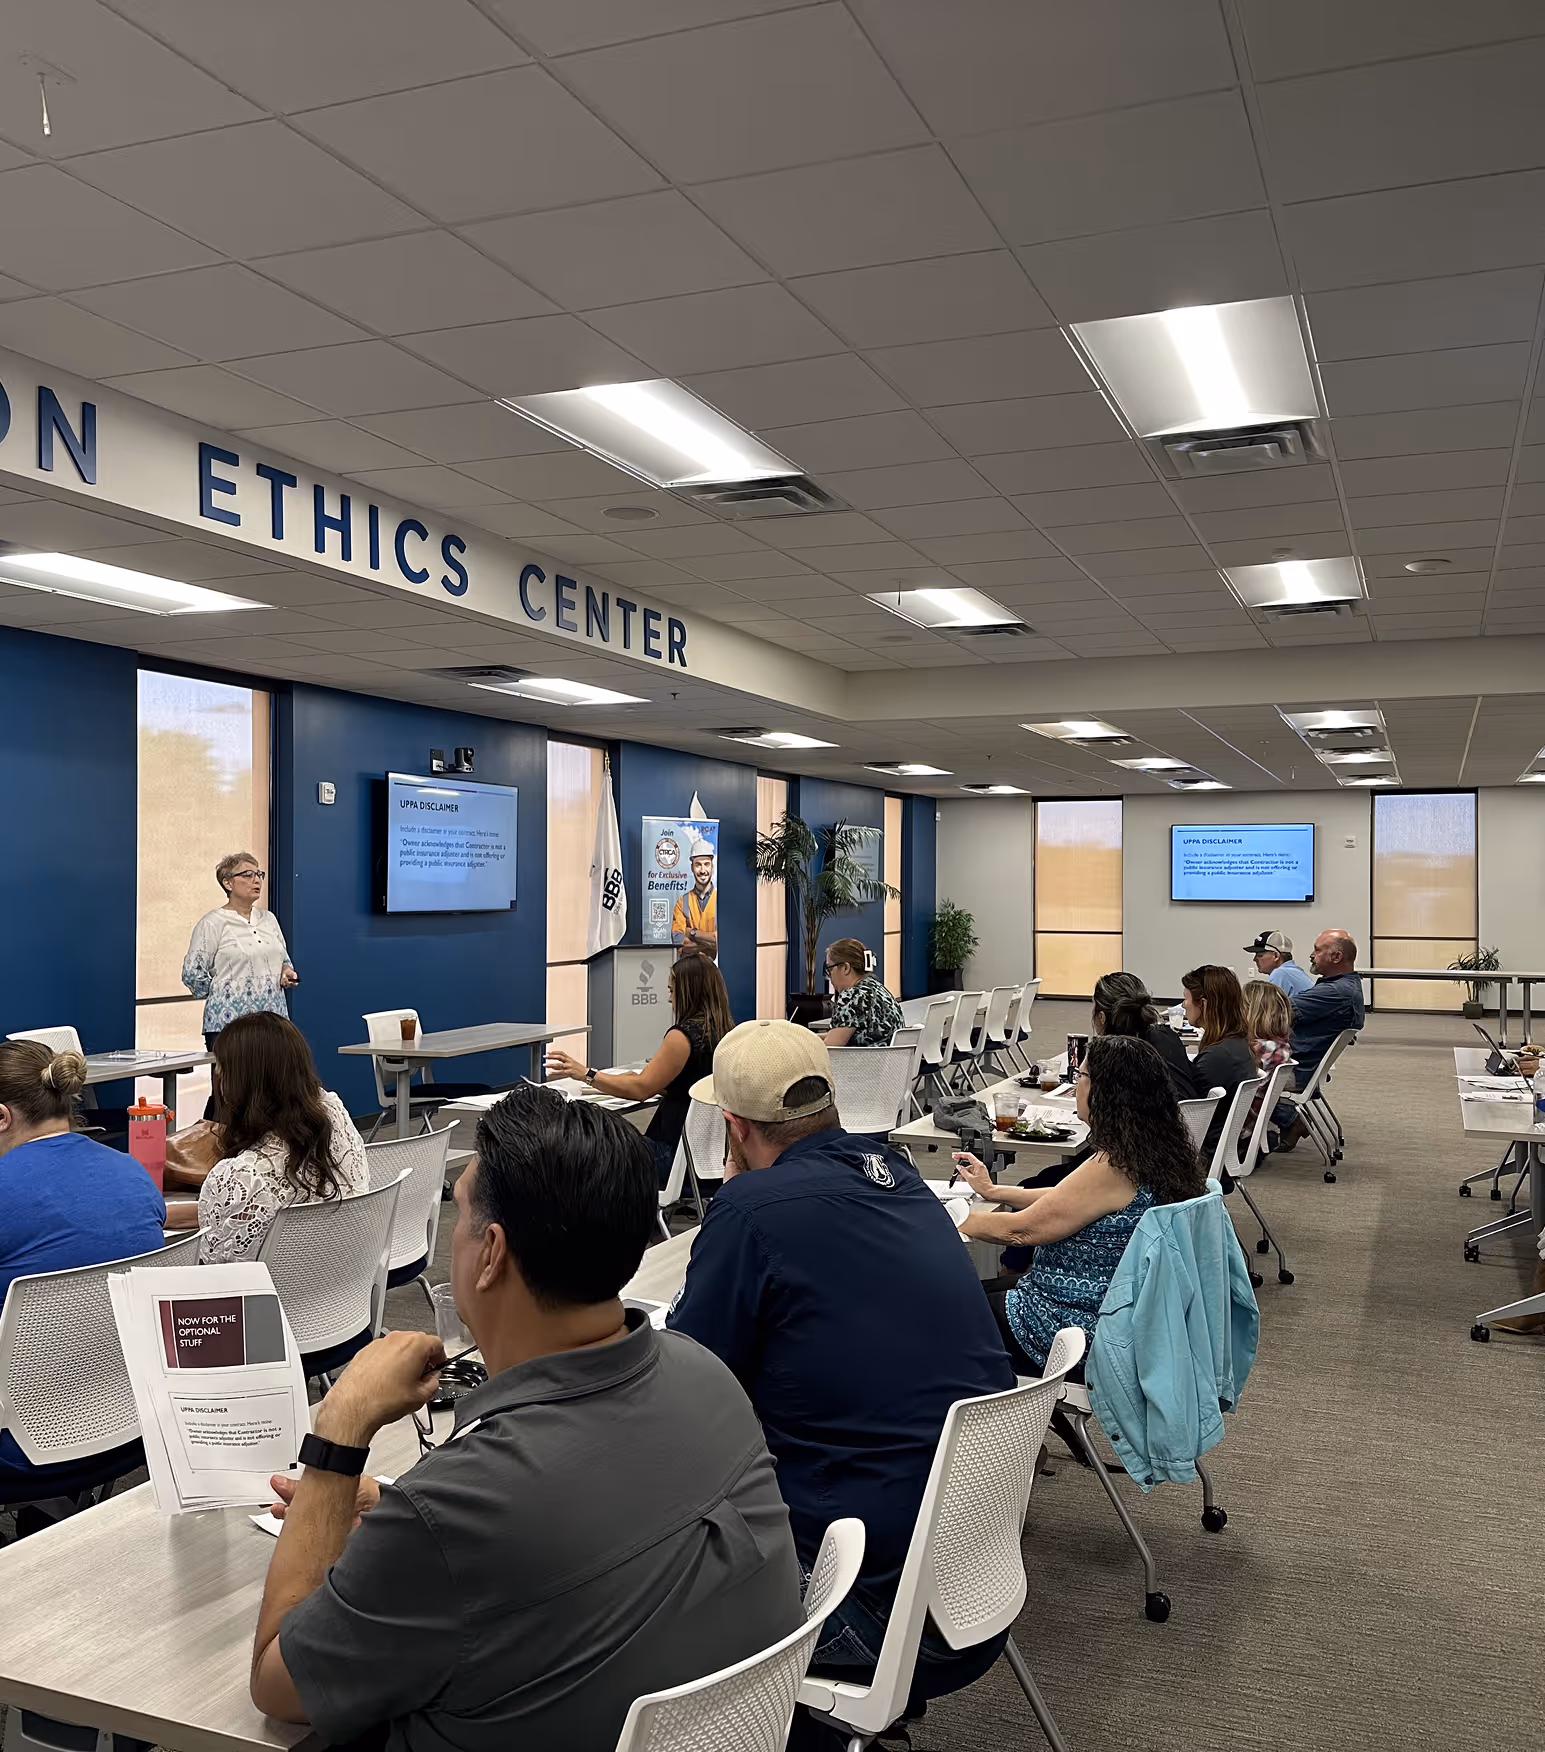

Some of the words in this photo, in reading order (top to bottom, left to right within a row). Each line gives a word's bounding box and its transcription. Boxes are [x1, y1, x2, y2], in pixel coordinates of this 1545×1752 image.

[0, 381, 96, 485] N
[199, 441, 469, 597] ETHICS
[518, 563, 688, 668] CENTER
[400, 800, 418, 809] UPPA
[420, 802, 459, 812] DISCLAIMER
[421, 840, 454, 849] acknowledges
[400, 849, 415, 857] public
[400, 859, 423, 868] providing
[428, 859, 443, 868] public
[602, 868, 623, 911] BBB
[648, 881, 687, 890] Benefits!
[632, 993, 658, 1005] BBB
[178, 1317, 200, 1326] NOW
[201, 1316, 219, 1325] FOR
[219, 1314, 237, 1323] THE
[179, 1327, 221, 1336] OPTIONAL
[180, 1338, 202, 1347] STUFF
